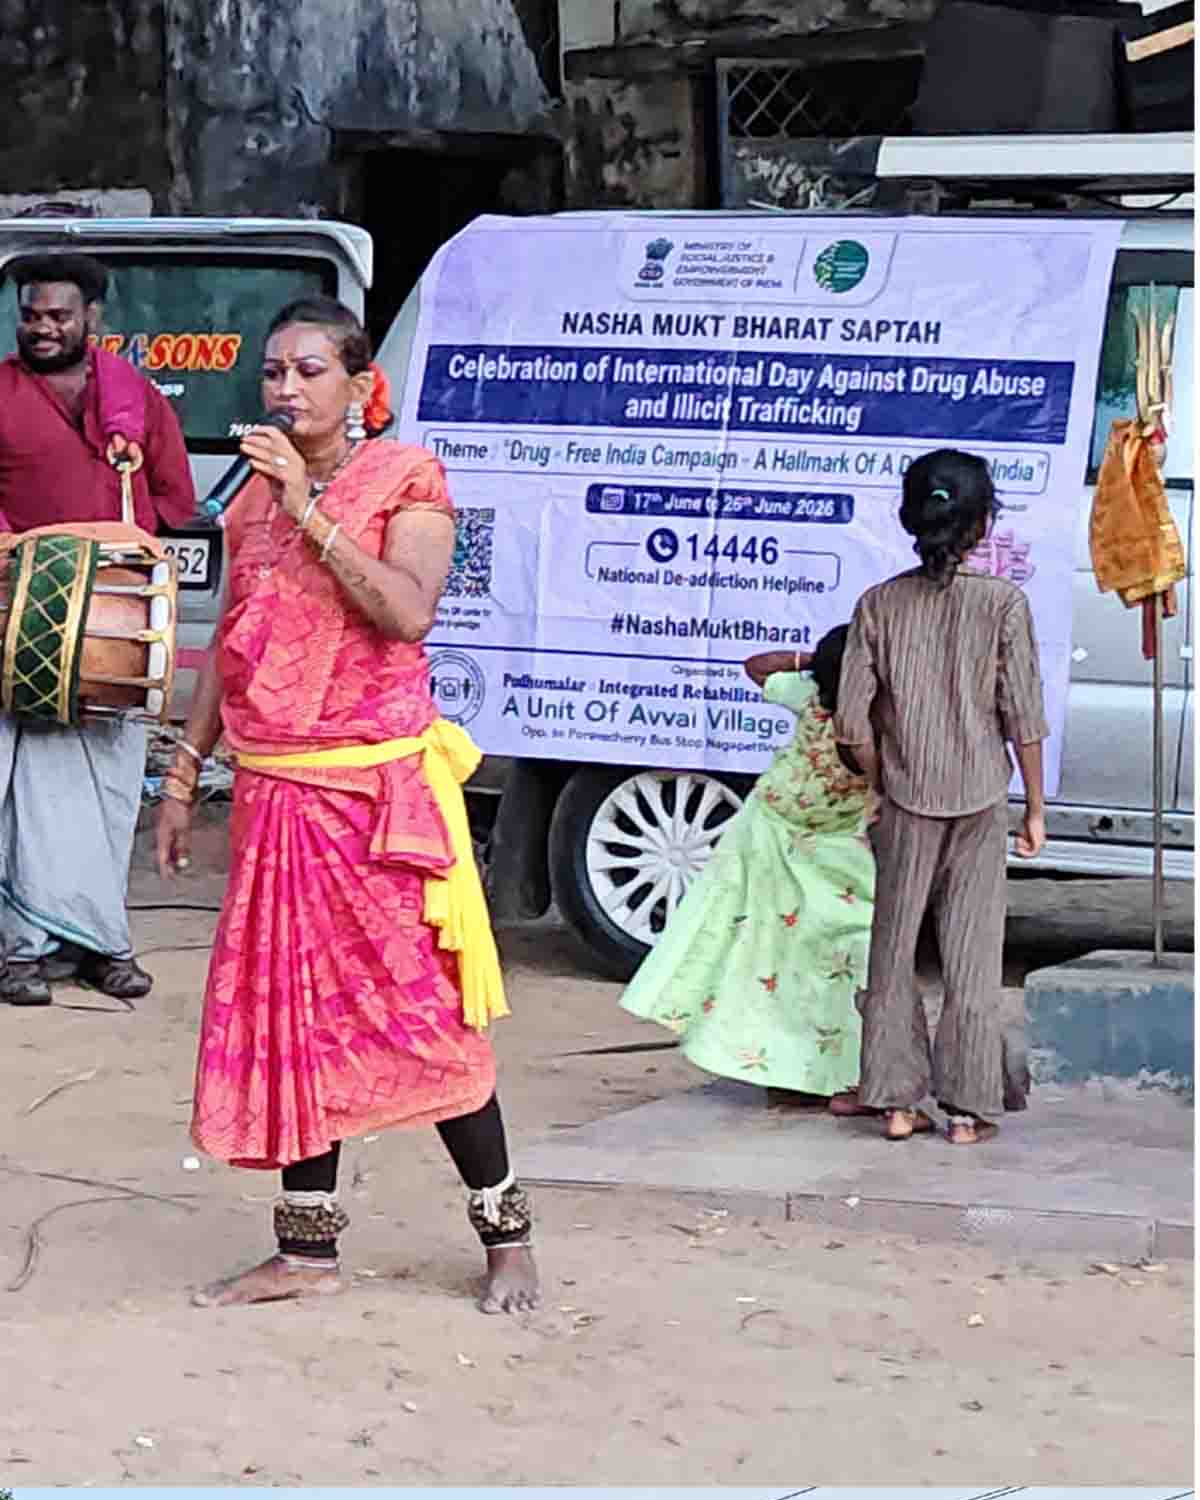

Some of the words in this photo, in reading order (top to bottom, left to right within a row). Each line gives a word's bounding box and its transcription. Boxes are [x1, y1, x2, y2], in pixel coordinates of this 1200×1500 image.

[561, 312, 644, 336] NASHA
[652, 314, 723, 338] MUKT
[732, 316, 833, 341] BHARAT
[839, 319, 942, 344] SAPTAH
[146, 333, 241, 371] SONS
[449, 353, 578, 382] Celebration
[583, 356, 609, 382] of
[613, 357, 762, 387] International
[768, 361, 814, 394] Day
[817, 363, 907, 396] Against
[910, 366, 968, 400] Drug
[971, 368, 1046, 396] Abuse
[625, 392, 667, 420] and
[672, 393, 731, 423] Illicit
[737, 397, 862, 432] Trafficking
[432, 437, 488, 459] Theme
[565, 441, 601, 464] Free
[605, 444, 647, 466] India
[651, 444, 738, 472] Campaign
[753, 447, 767, 471] A
[771, 449, 850, 475] Hallmark
[854, 452, 876, 475] Of
[879, 453, 894, 476] A
[664, 493, 702, 513] June
[754, 496, 792, 515] June
[686, 532, 779, 565] 14446
[598, 566, 659, 586] National
[663, 568, 758, 591] De-addiction
[762, 571, 825, 595] Helpline
[610, 613, 811, 645] #NashaMuktBharat
[599, 679, 679, 699] Integrated
[682, 684, 764, 703] Rehabilita
[502, 694, 519, 717] A
[527, 695, 575, 721] Unit
[584, 699, 619, 724] Of
[628, 703, 697, 729] Avvai
[707, 707, 790, 739] Village
